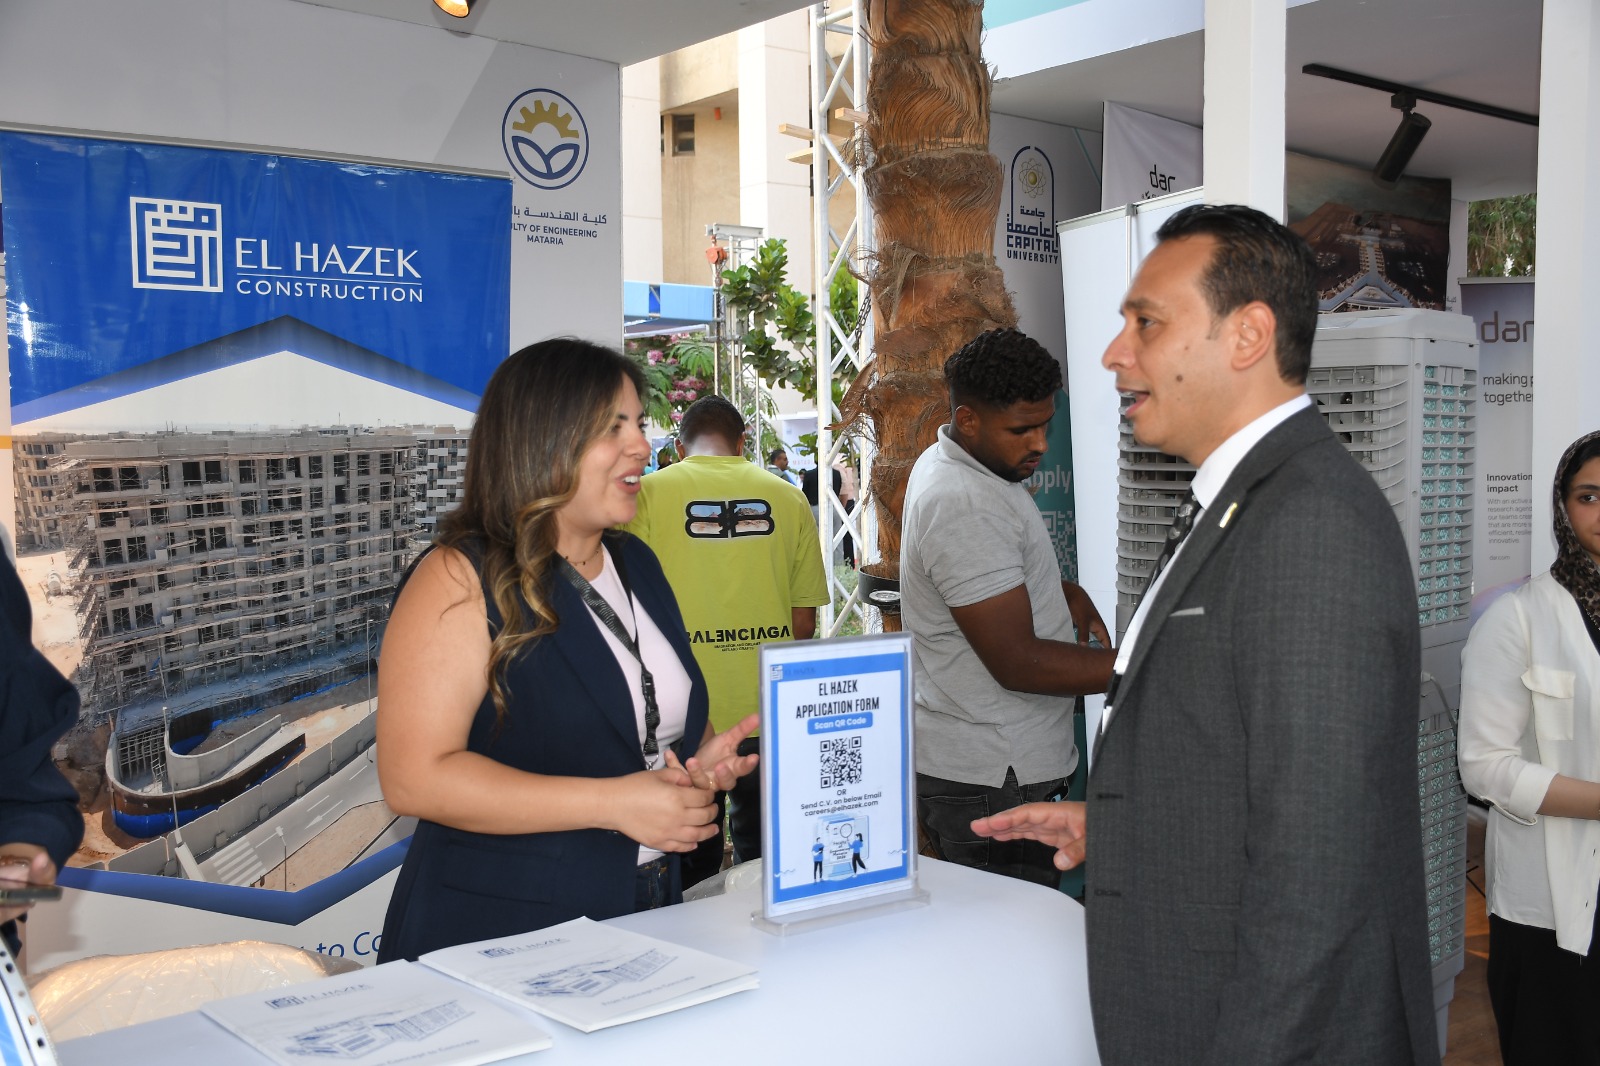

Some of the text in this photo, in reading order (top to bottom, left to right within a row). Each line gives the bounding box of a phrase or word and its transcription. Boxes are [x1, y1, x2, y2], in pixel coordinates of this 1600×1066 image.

[1149, 164, 1176, 192] dar
[524, 206, 579, 221] الهندسة
[583, 212, 607, 225] كلية
[1020, 206, 1046, 220] جامعة
[529, 224, 541, 233] OF
[543, 225, 598, 238] ENGINEERING
[527, 234, 564, 245] MATARIA
[1007, 234, 1059, 253] CAPITAL
[235, 237, 422, 278] EL HAZEK
[1007, 249, 1059, 264] UNIVERSITY
[236, 279, 423, 303] CONSTRUCTION
[1481, 310, 1534, 343] dar
[1483, 373, 1528, 388] making
[1484, 391, 1533, 406] togethe
[1486, 472, 1532, 482] Innovation
[1487, 484, 1519, 494] impact
[819, 679, 858, 696] EL HAZEK
[795, 696, 880, 719] APPLICATION FORM
[814, 716, 867, 730] Scan QR Code
[836, 788, 847, 796] OR
[800, 802, 818, 810] Send
[843, 795, 863, 803] below
[863, 791, 882, 800] Email
[804, 800, 879, 816] careers@elhazek.com
